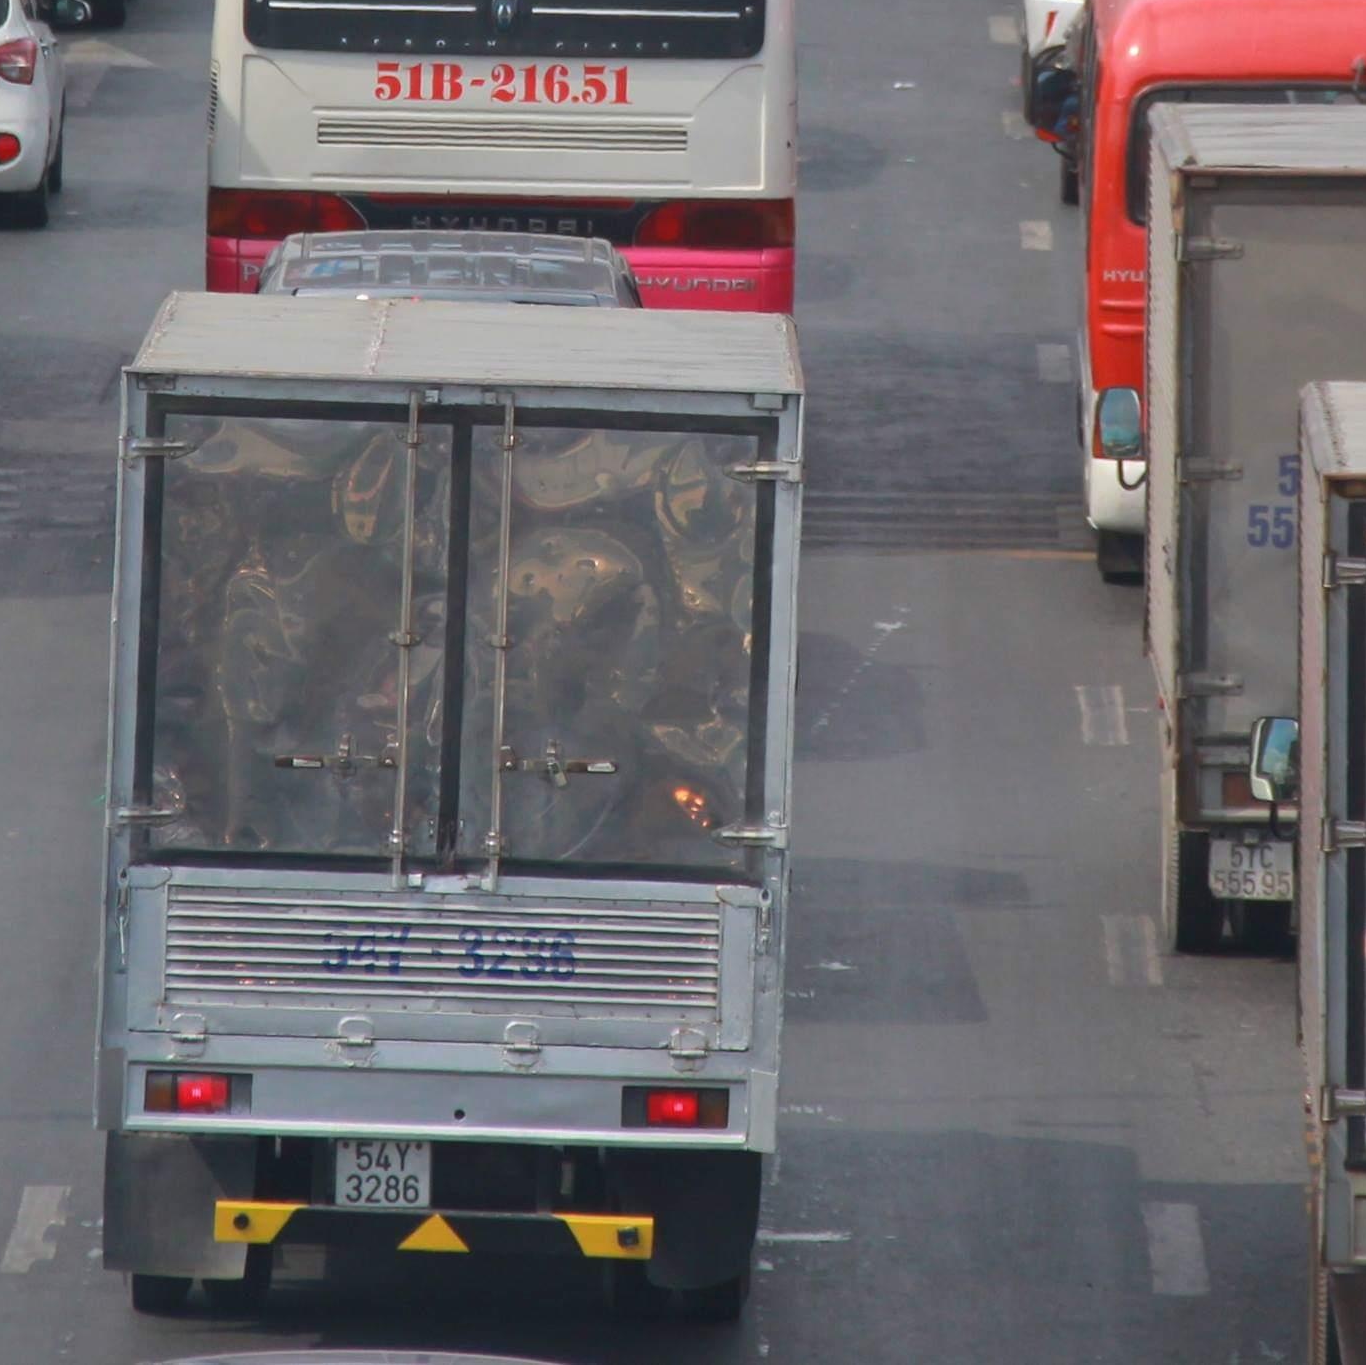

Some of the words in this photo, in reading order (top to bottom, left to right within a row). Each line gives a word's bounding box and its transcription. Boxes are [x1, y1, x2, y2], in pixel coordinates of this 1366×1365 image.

[374, 60, 633, 106] 51B-216.51
[354, 1141, 410, 1173] 54Y
[344, 1174, 422, 1205] 3286
